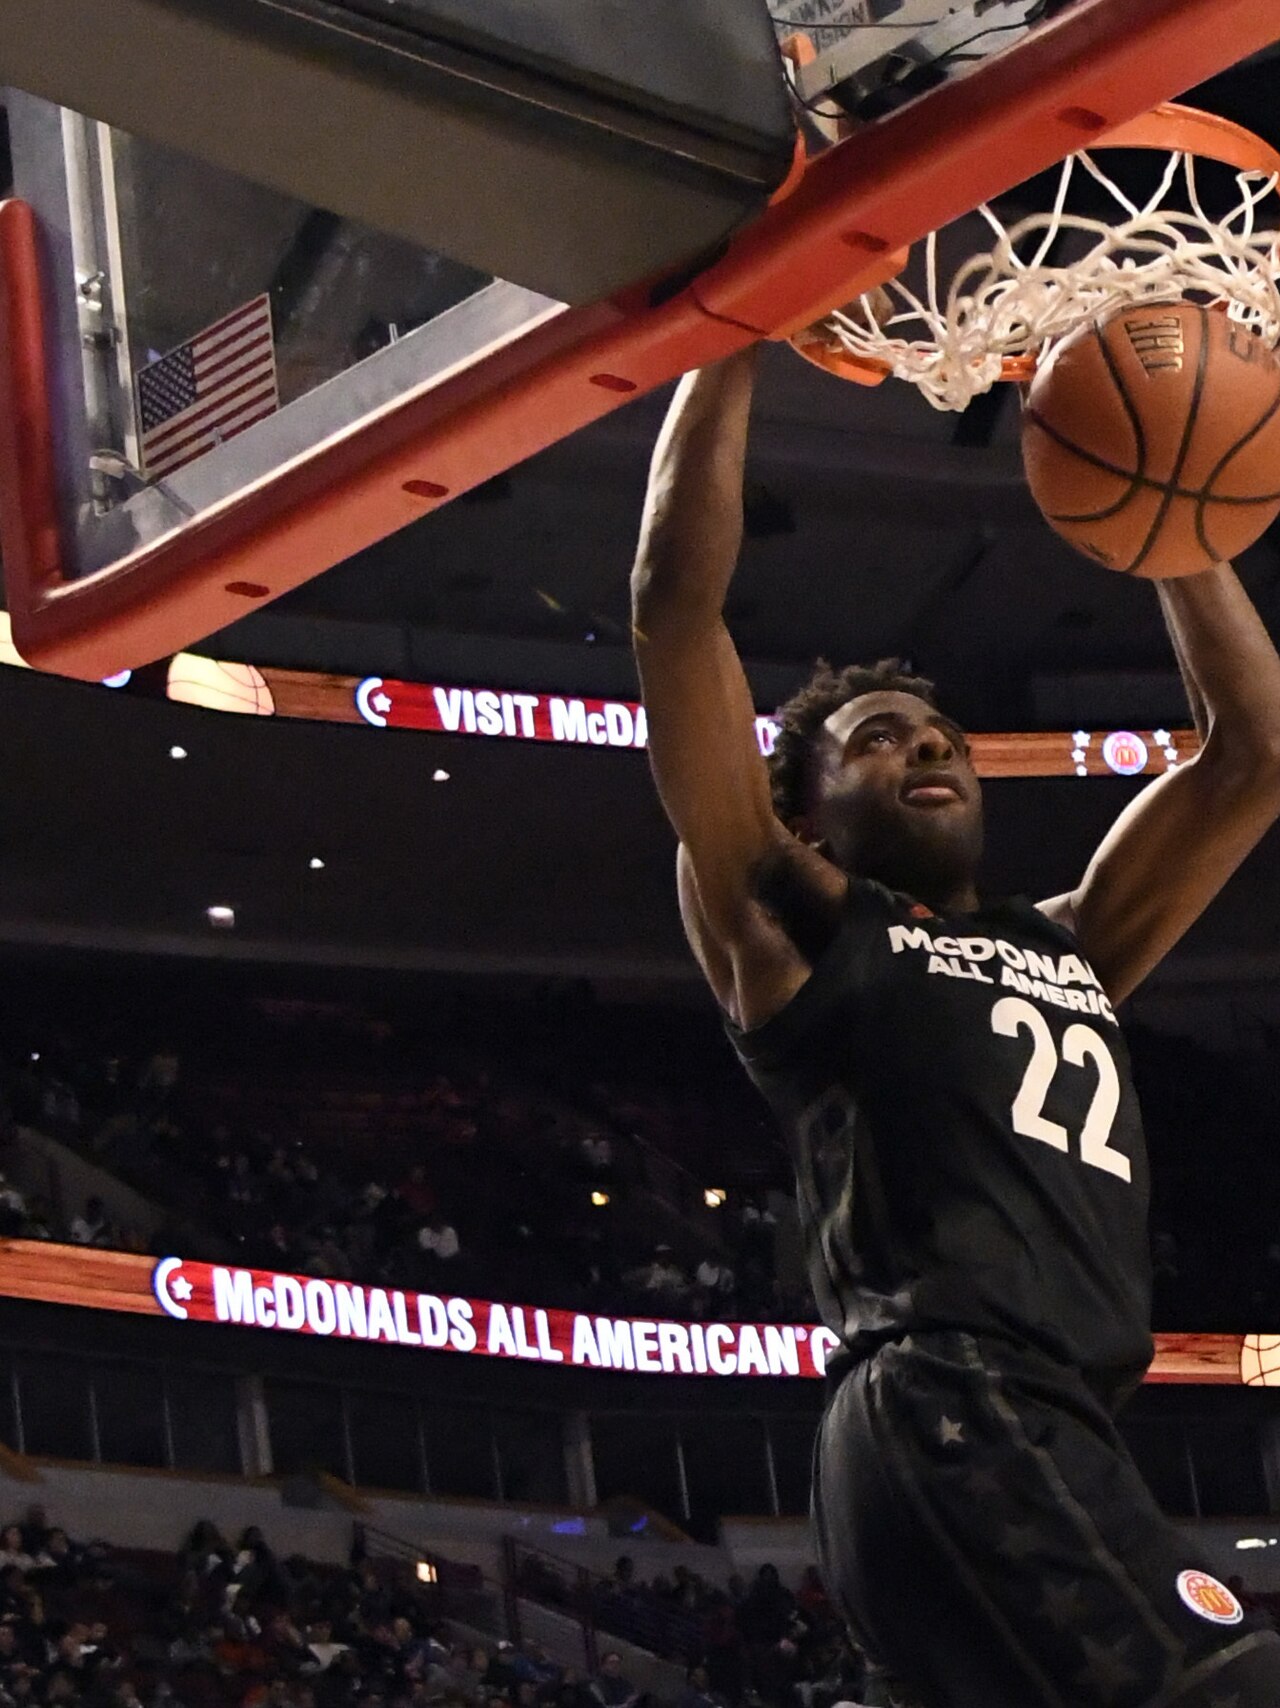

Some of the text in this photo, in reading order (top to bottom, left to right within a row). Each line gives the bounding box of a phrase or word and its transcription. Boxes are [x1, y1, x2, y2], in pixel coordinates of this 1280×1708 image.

[433, 687, 539, 738] VISIT
[928, 955, 1119, 1027] ALL AMERIC
[991, 997, 1131, 1184] 22
[212, 1267, 477, 1352] McDONALDS
[487, 1303, 563, 1362] ALL
